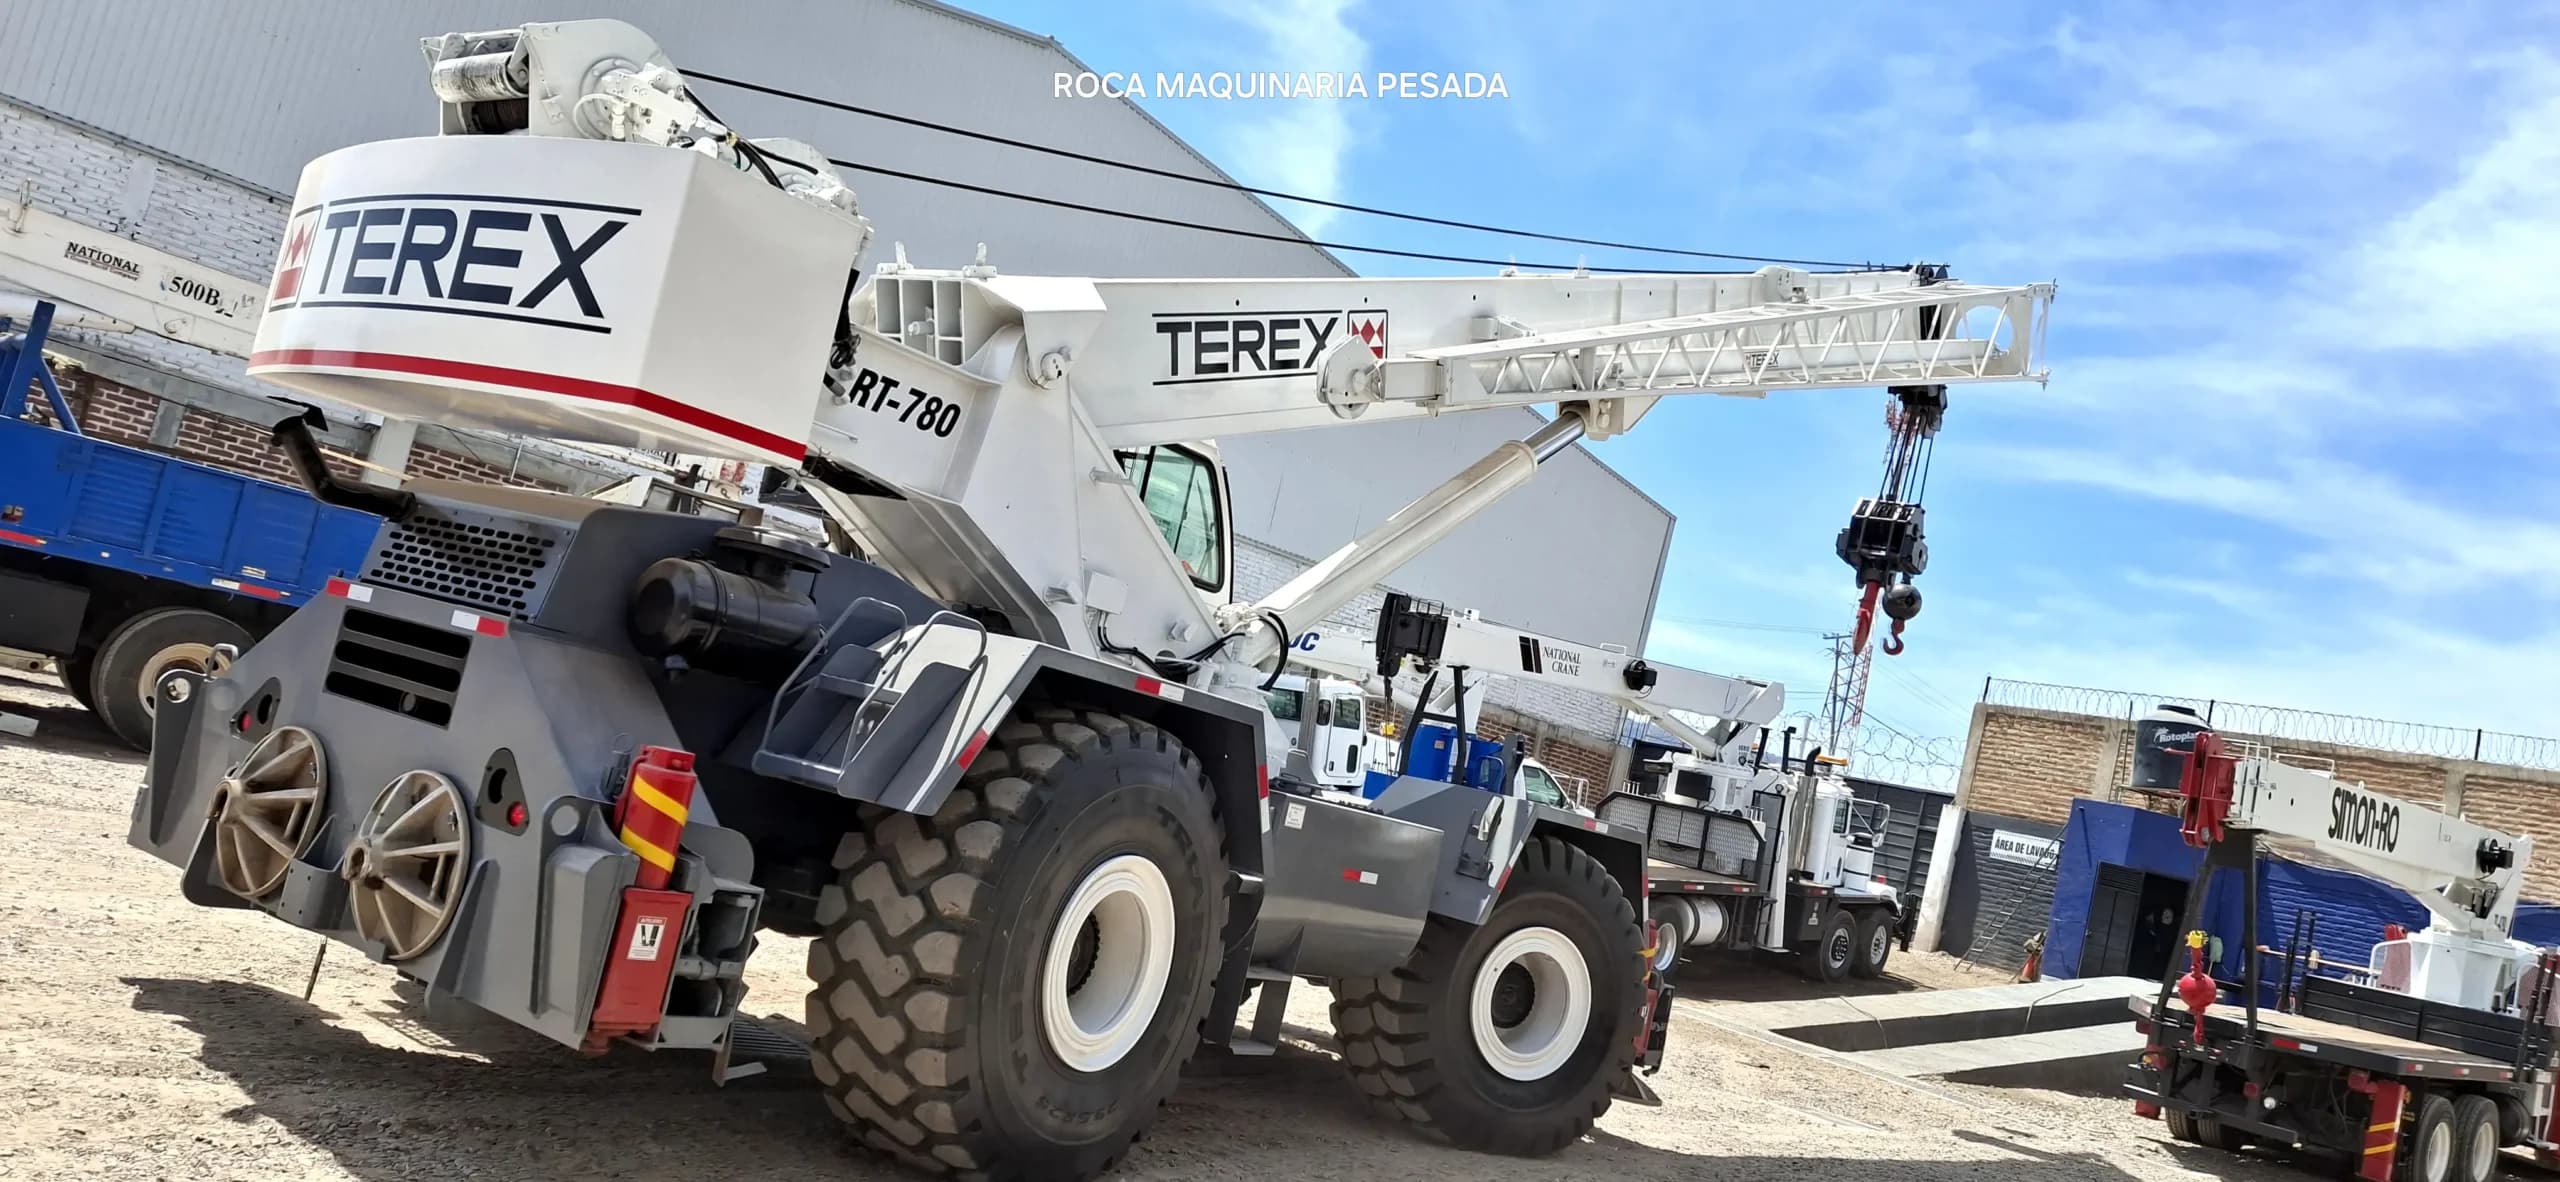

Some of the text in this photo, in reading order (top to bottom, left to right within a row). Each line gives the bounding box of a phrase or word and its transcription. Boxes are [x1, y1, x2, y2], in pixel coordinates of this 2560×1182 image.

[67, 241, 141, 274] NATIONAL
[318, 207, 630, 319] TEREX
[169, 276, 220, 306] 500B
[1155, 317, 1339, 376] TEREX
[848, 368, 962, 438] RT-780
[1543, 646, 1581, 665] NATIONAL
[1551, 661, 1580, 676] CRANE
[2160, 731, 2196, 743] Rotopla
[1994, 836, 2014, 852] ÁREA
[2015, 842, 2025, 854] DE
